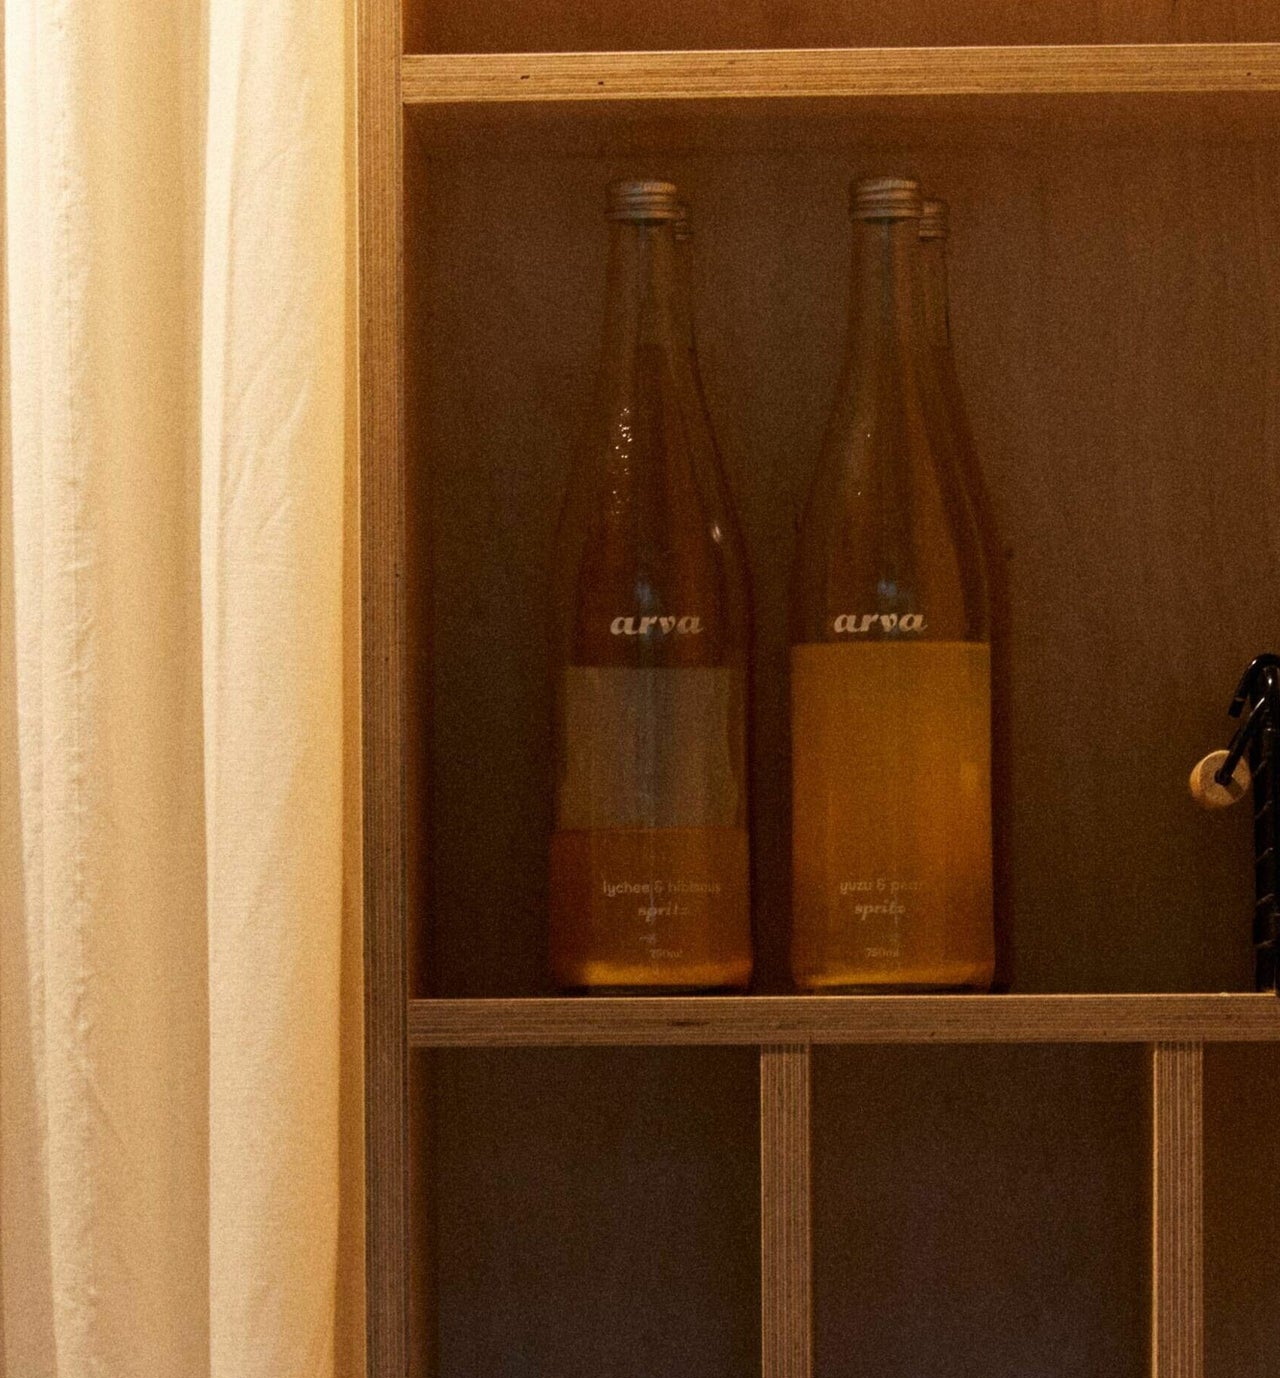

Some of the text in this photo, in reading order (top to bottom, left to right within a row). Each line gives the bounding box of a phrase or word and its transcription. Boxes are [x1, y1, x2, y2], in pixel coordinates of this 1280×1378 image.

[609, 612, 703, 636] arva
[833, 610, 928, 634] arva
[602, 879, 650, 897] lychee
[840, 881, 872, 895] yuzu
